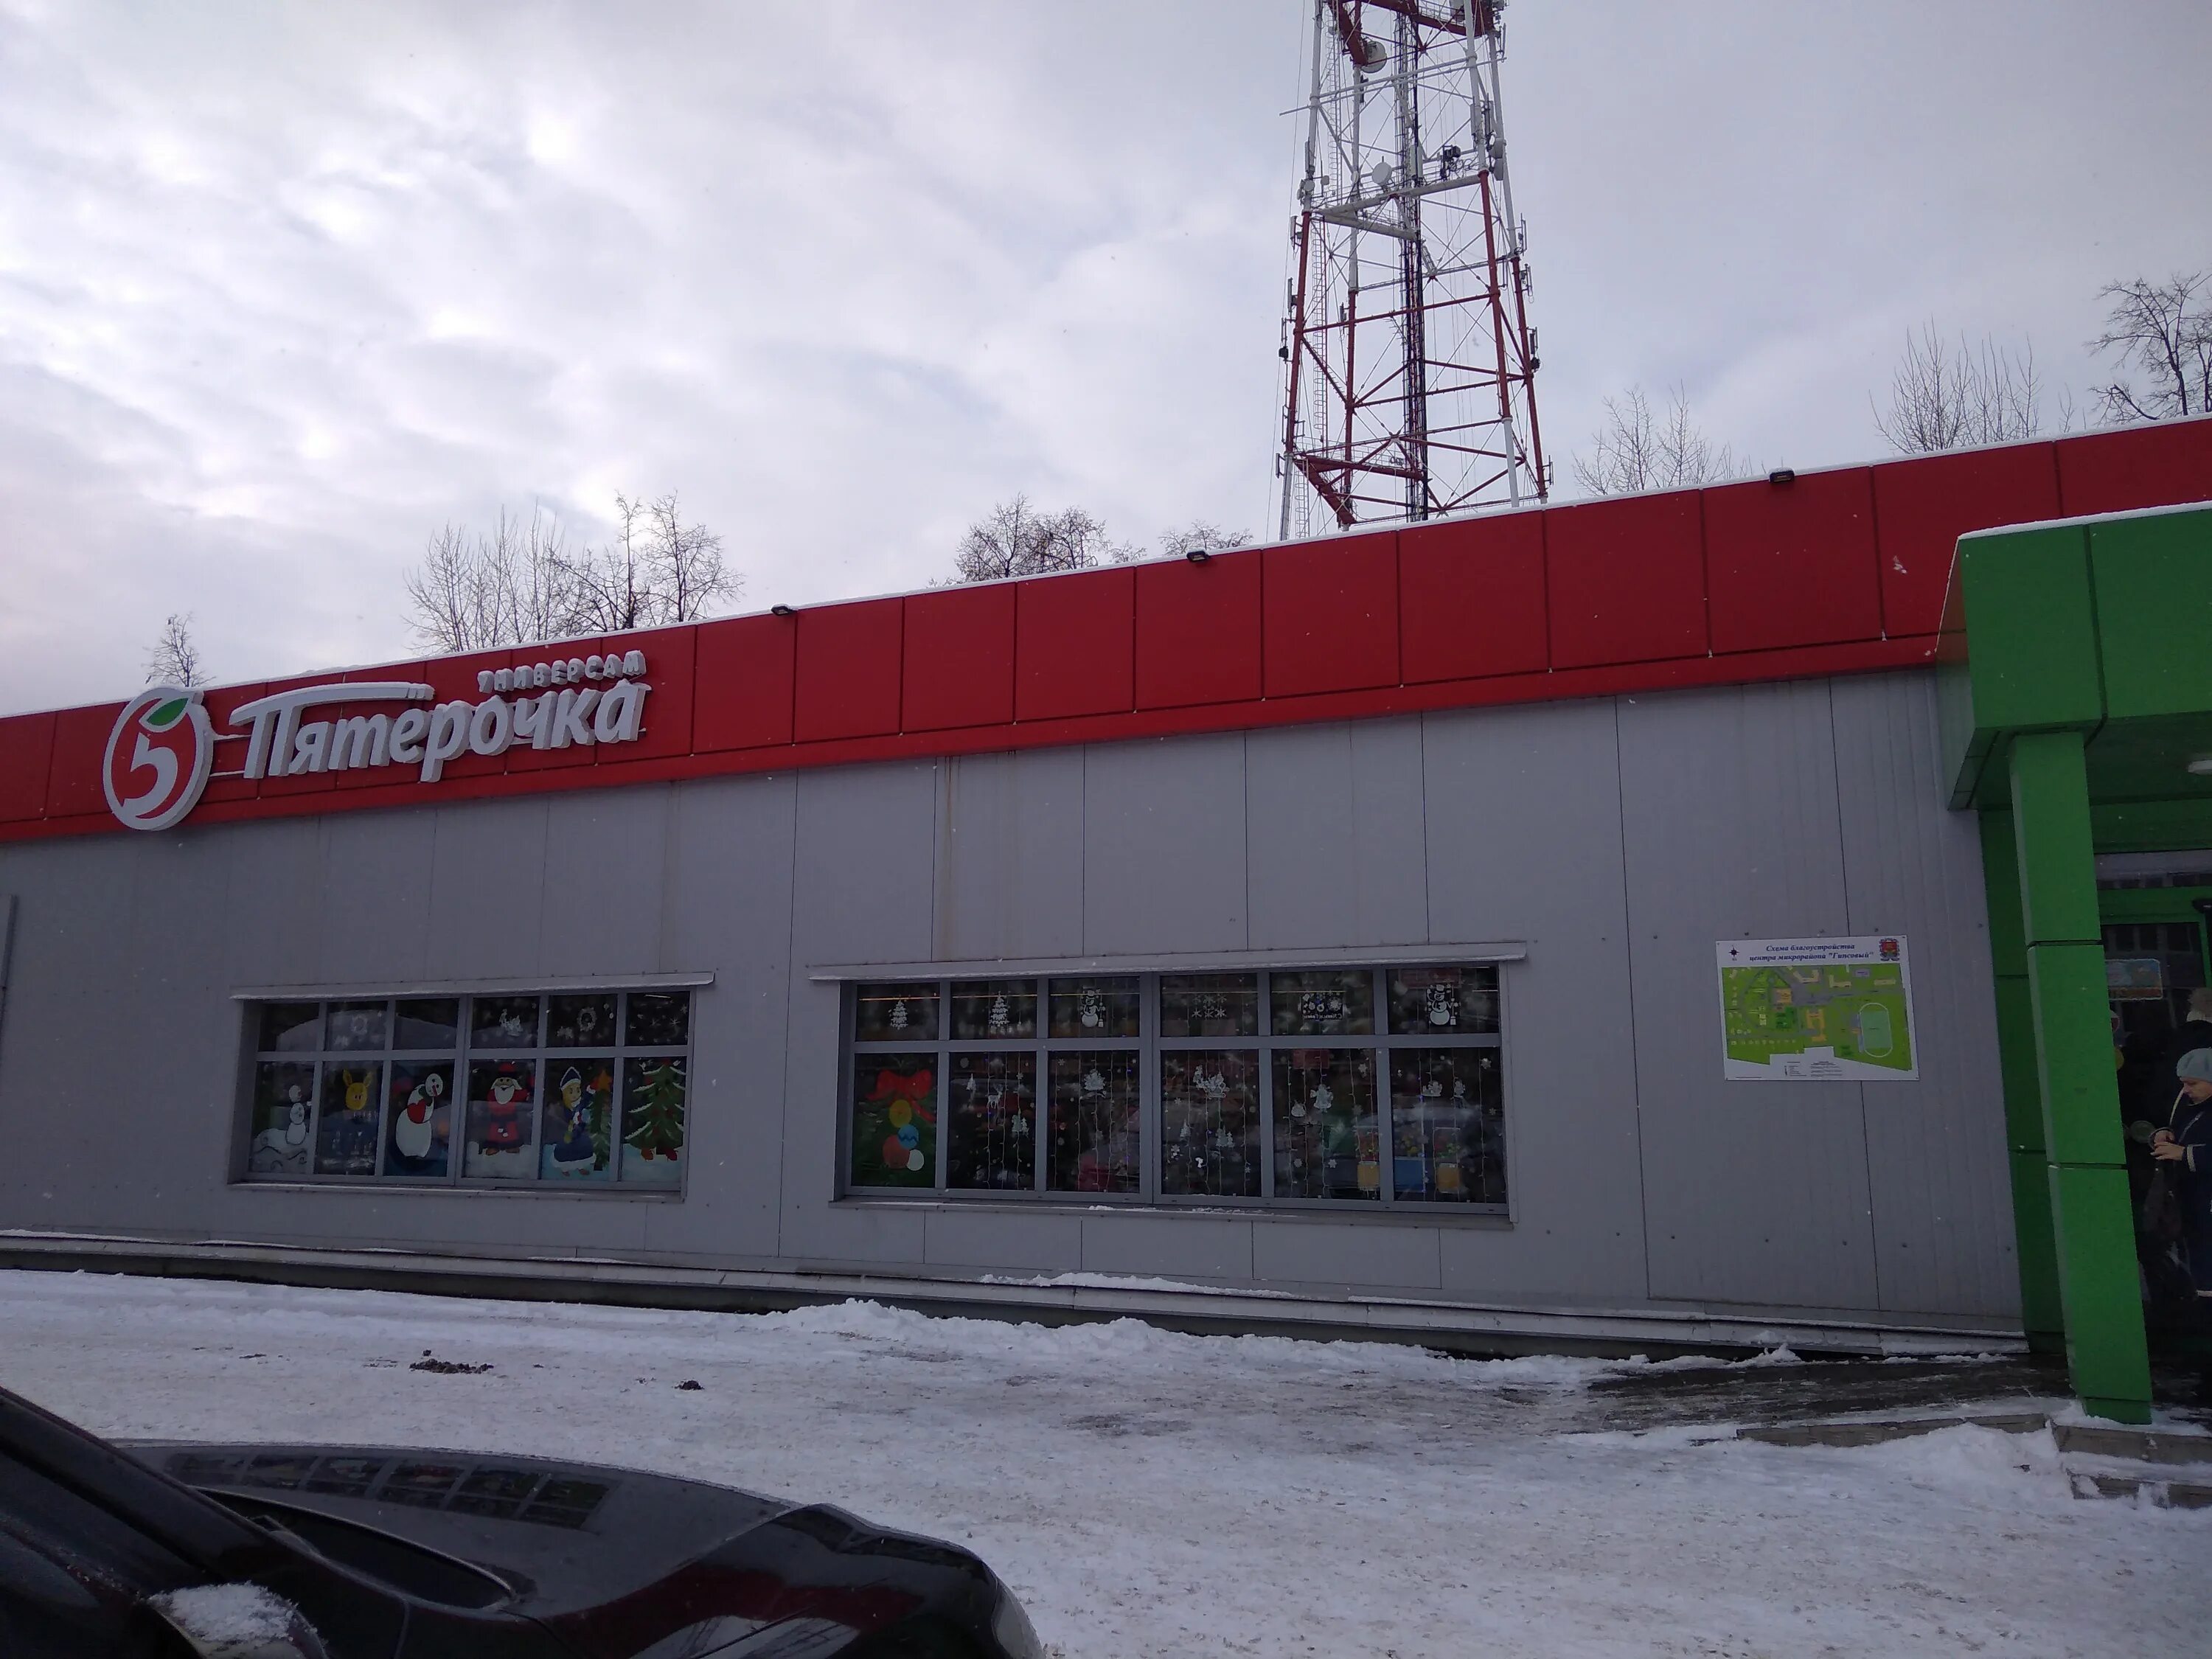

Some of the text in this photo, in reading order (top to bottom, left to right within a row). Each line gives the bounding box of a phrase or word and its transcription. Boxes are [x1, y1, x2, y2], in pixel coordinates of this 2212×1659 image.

[477, 650, 647, 693] УНИВЕРСАМ
[124, 732, 178, 816] 5
[1790, 944, 1855, 952] благоустройства
